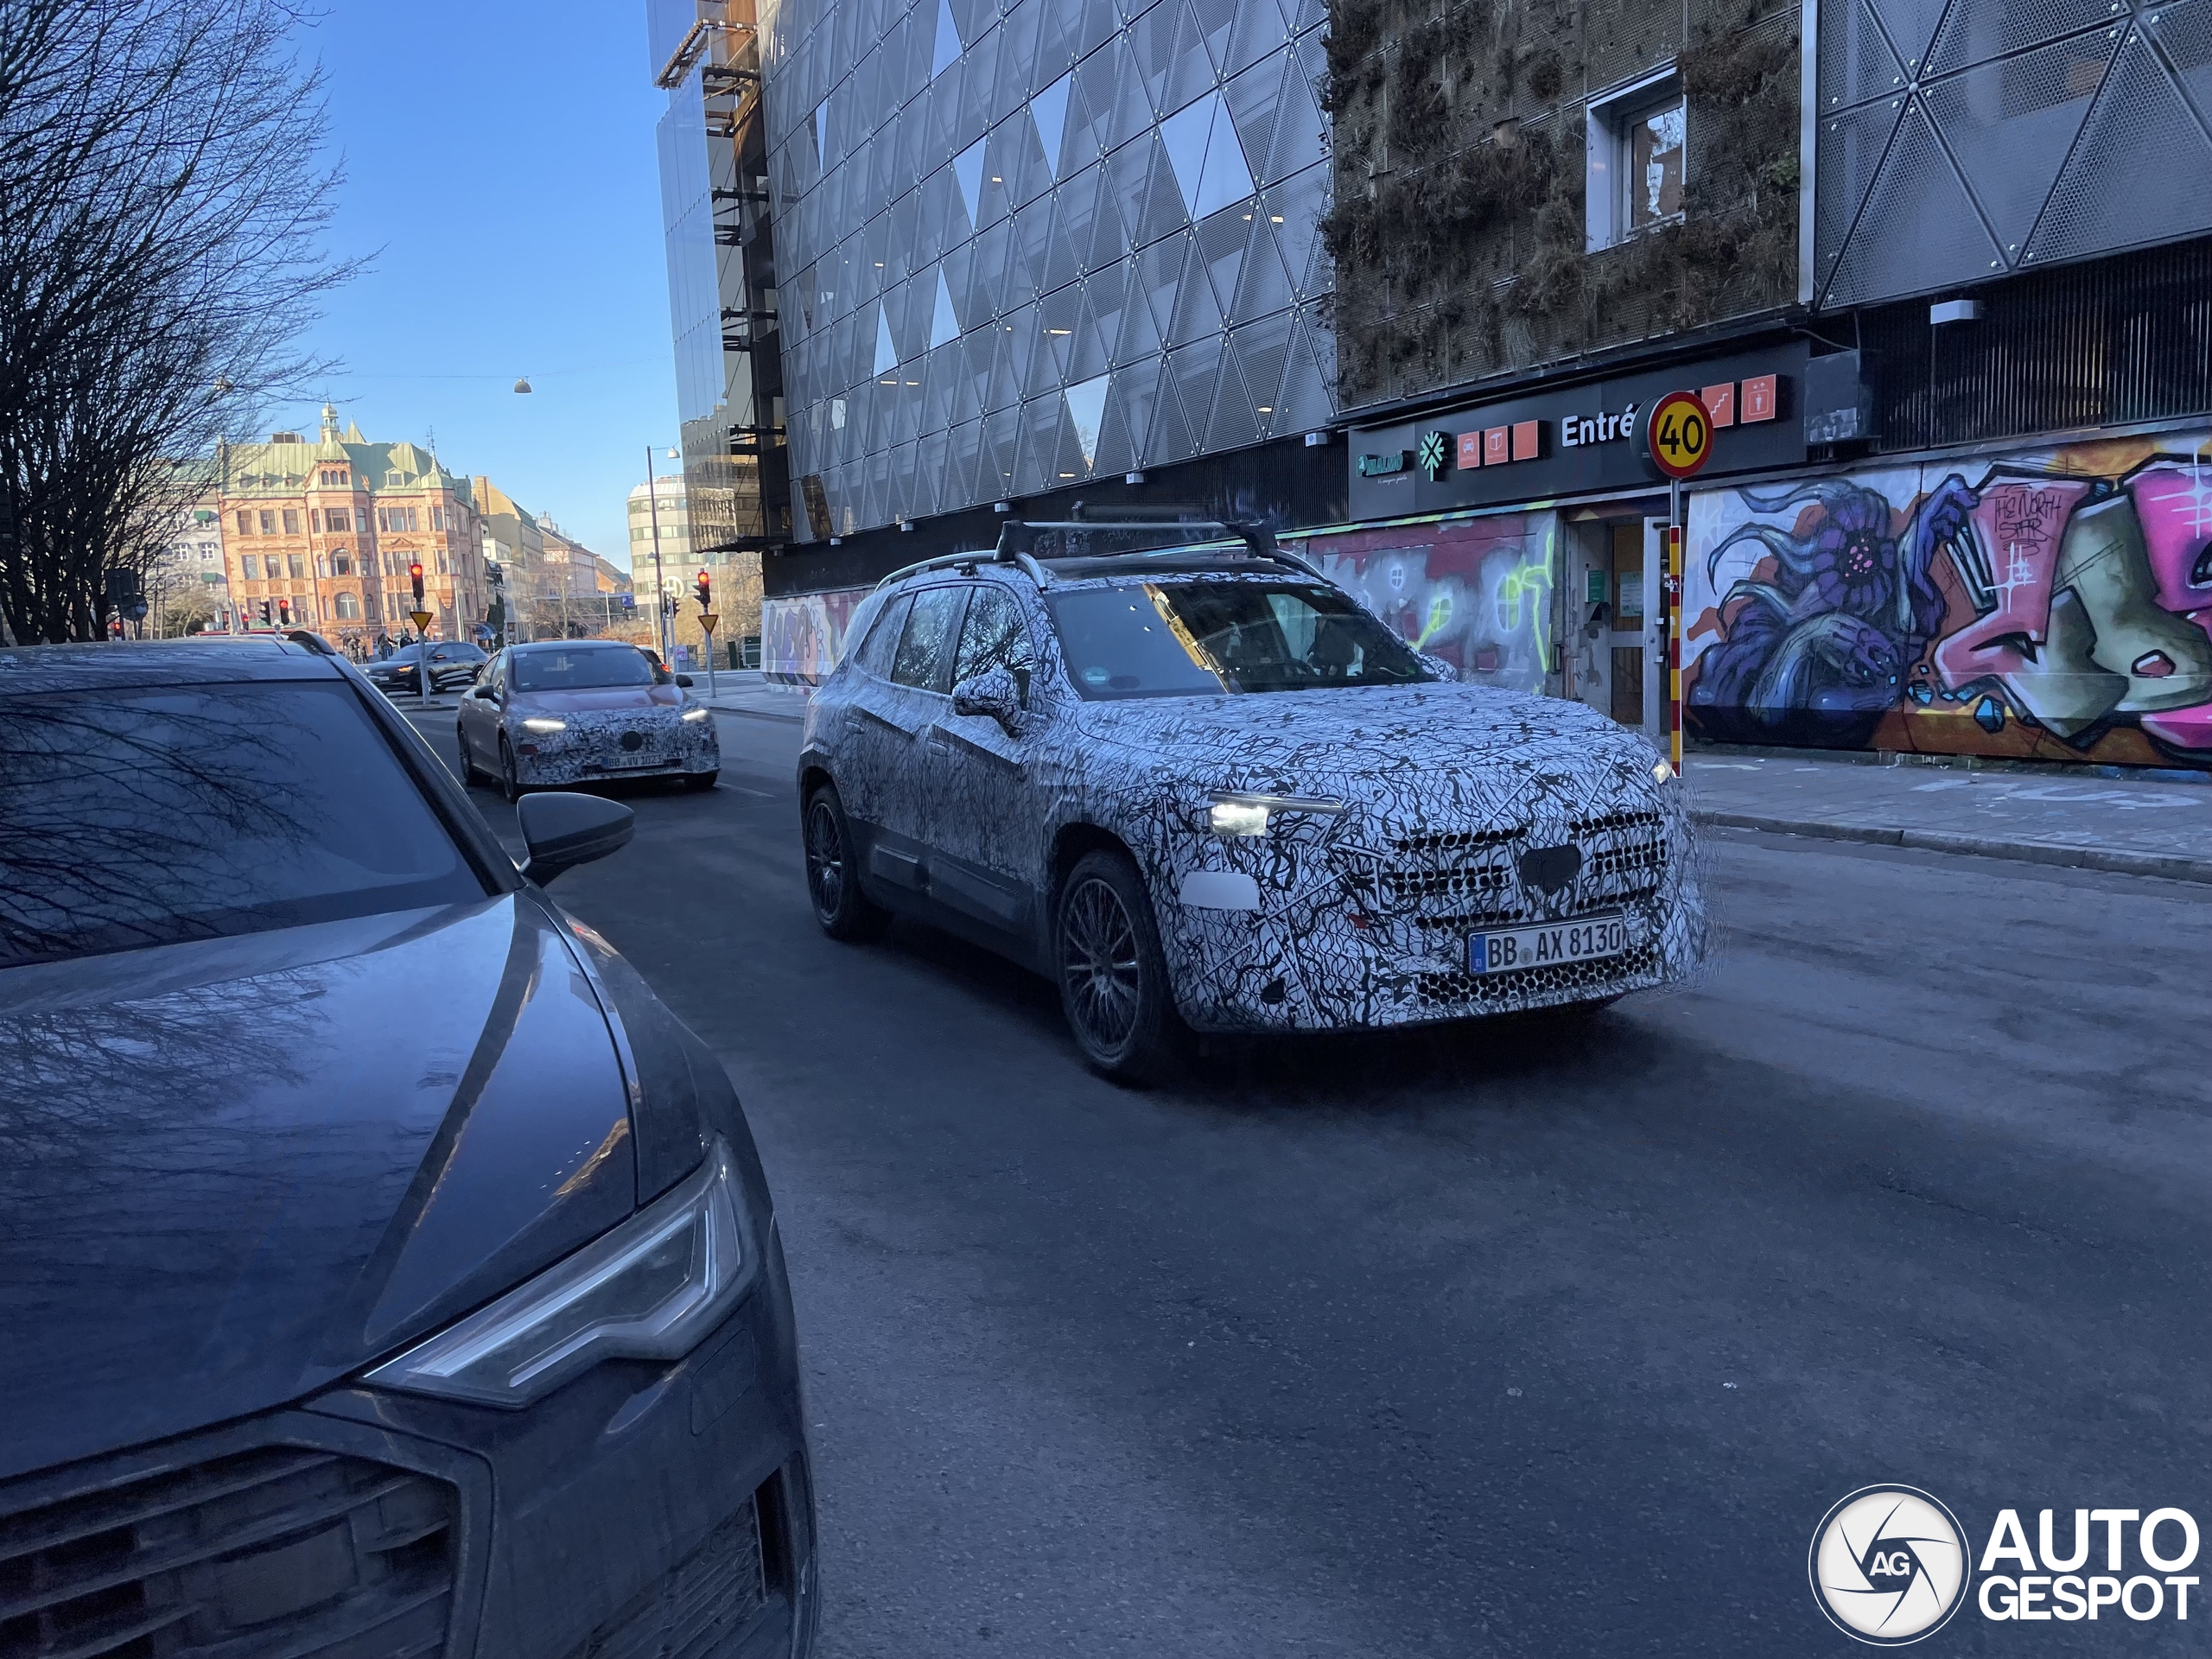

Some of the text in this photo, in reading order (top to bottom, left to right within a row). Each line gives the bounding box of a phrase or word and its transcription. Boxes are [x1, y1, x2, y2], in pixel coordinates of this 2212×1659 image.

[1561, 403, 1635, 448] Entré
[1659, 414, 1704, 455] 40
[1984, 491, 2062, 532] THE NORTH
[1999, 518, 2055, 541] STAR
[1488, 922, 1620, 968] BB AX 8130
